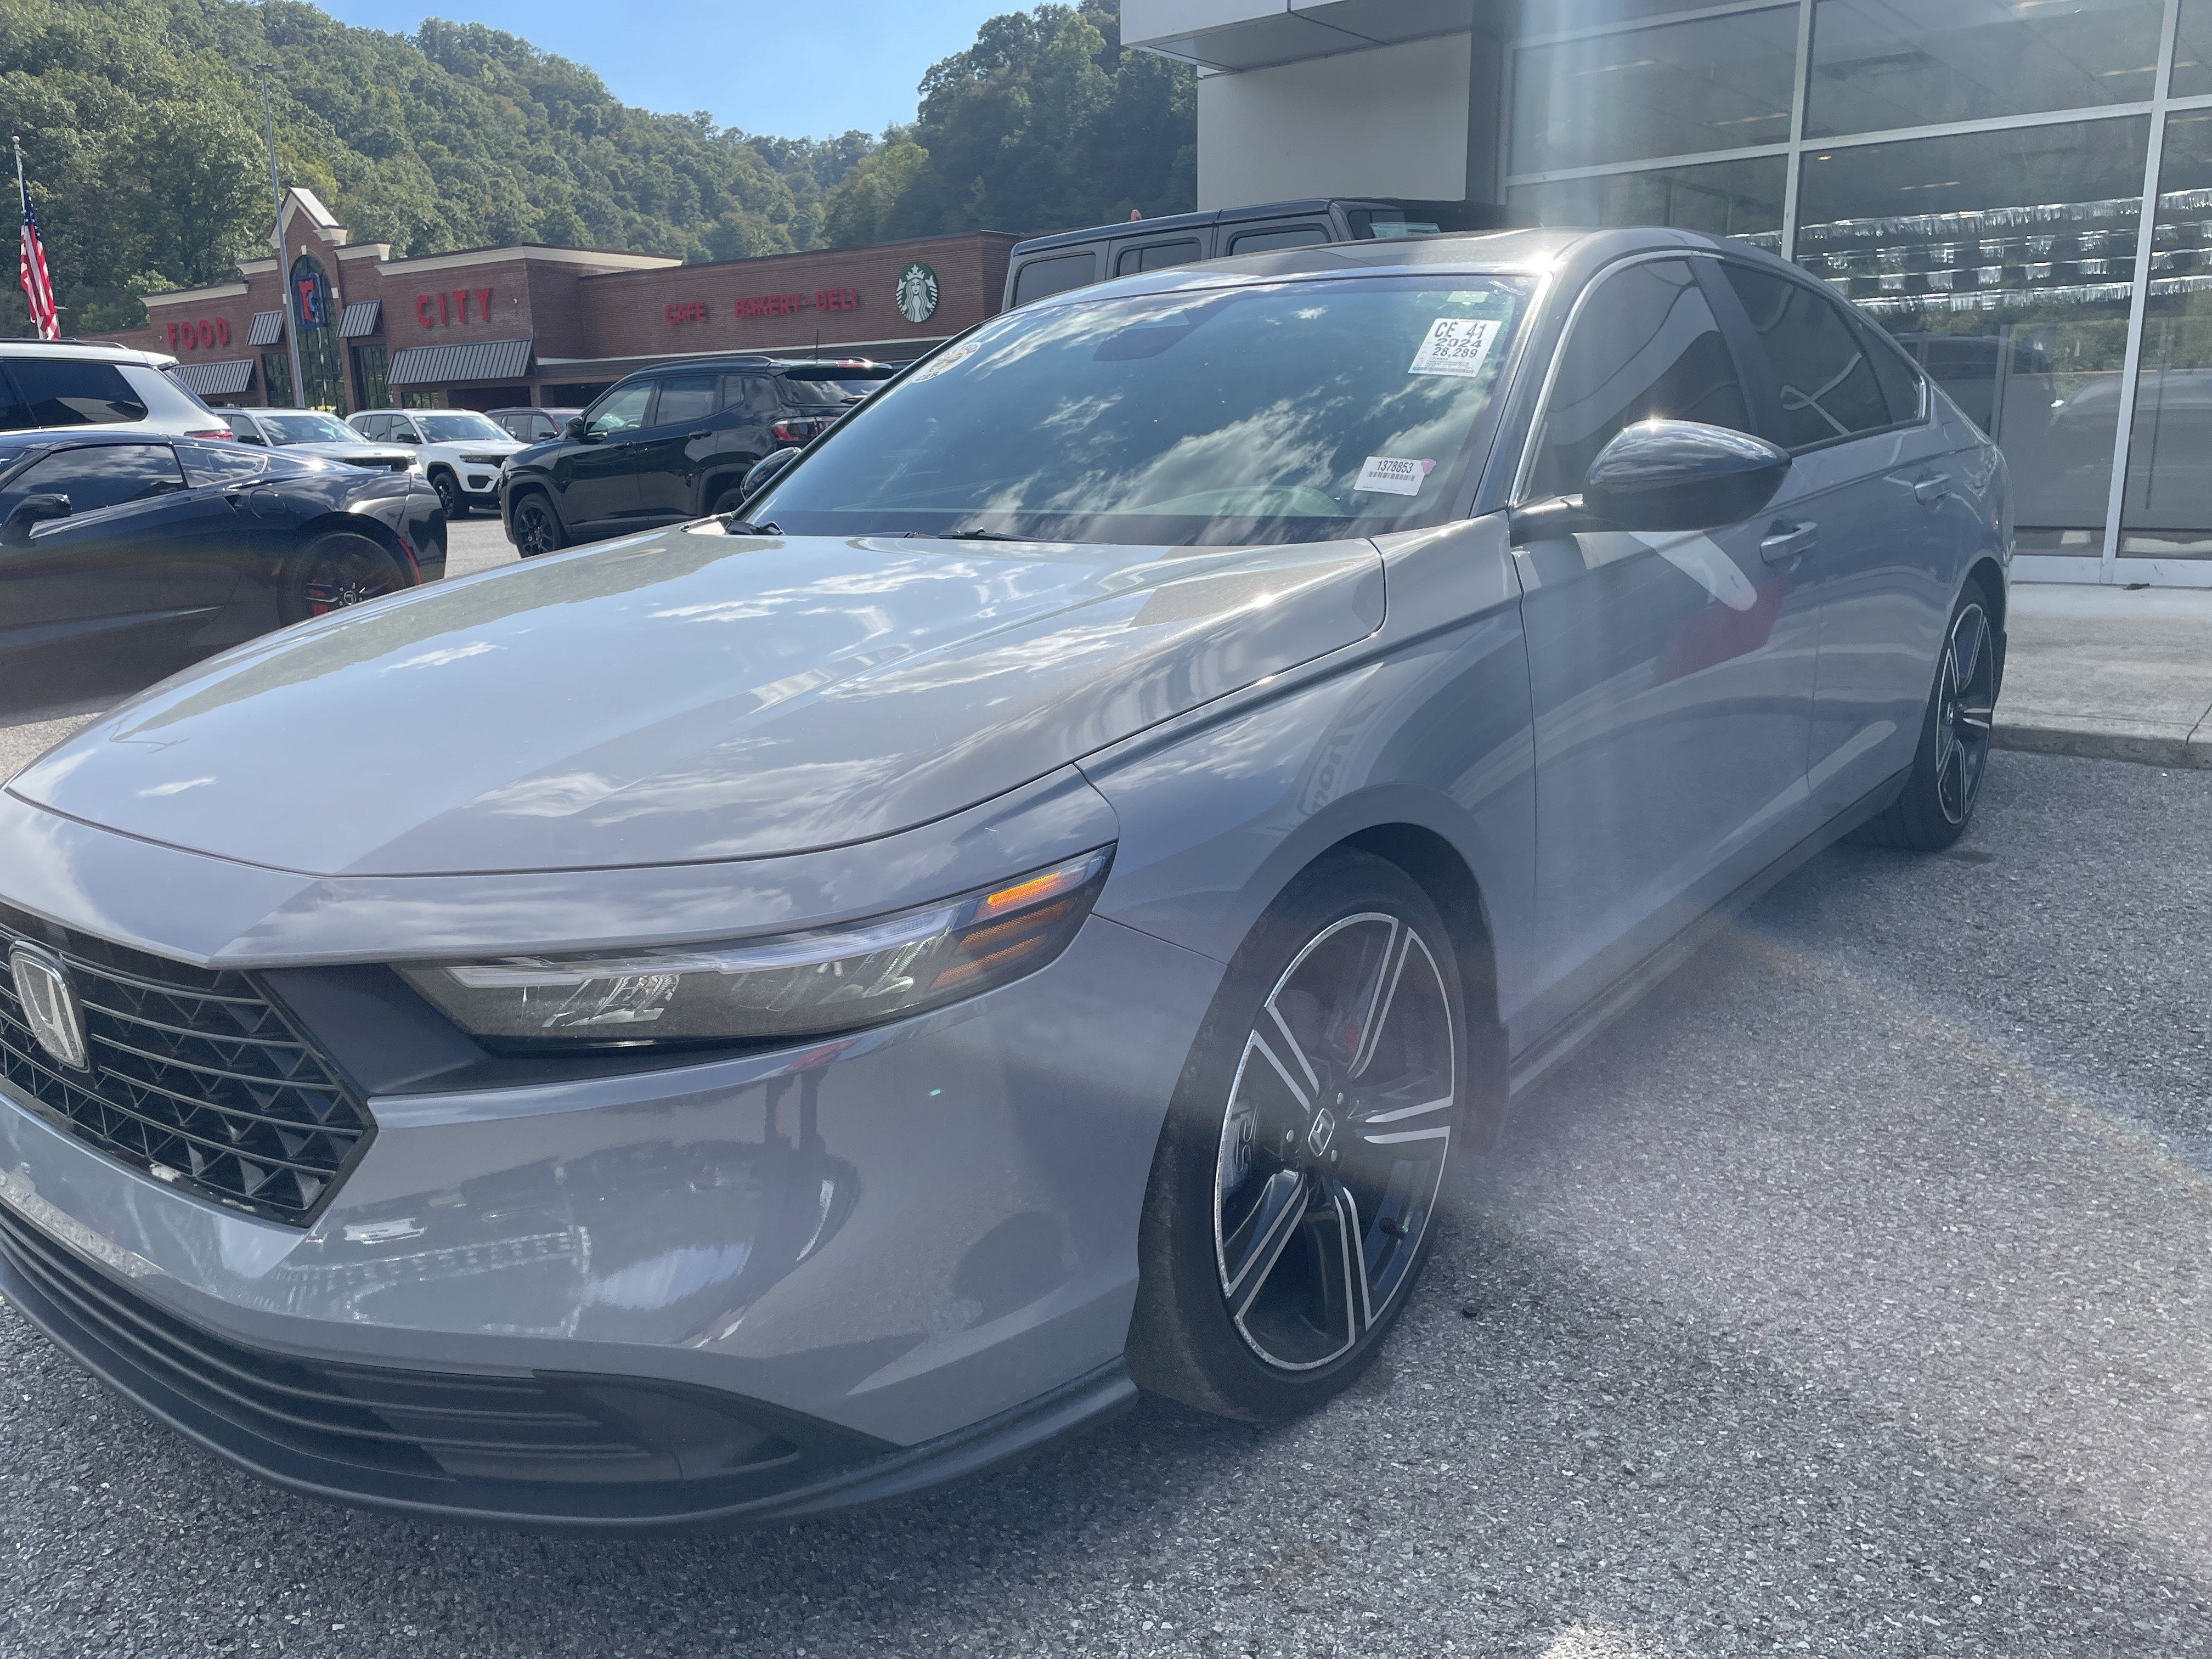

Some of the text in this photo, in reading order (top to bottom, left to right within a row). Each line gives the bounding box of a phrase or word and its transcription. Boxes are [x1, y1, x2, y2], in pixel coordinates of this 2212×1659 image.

[415, 286, 490, 328] CITY
[664, 302, 707, 324] CAFE
[734, 293, 800, 318] BAKERY
[815, 288, 856, 311] DELI
[166, 317, 228, 349] FOOD
[1434, 337, 1482, 348] 2024
[1431, 347, 1478, 358] 28,289
[1377, 460, 1414, 473] 1378853
